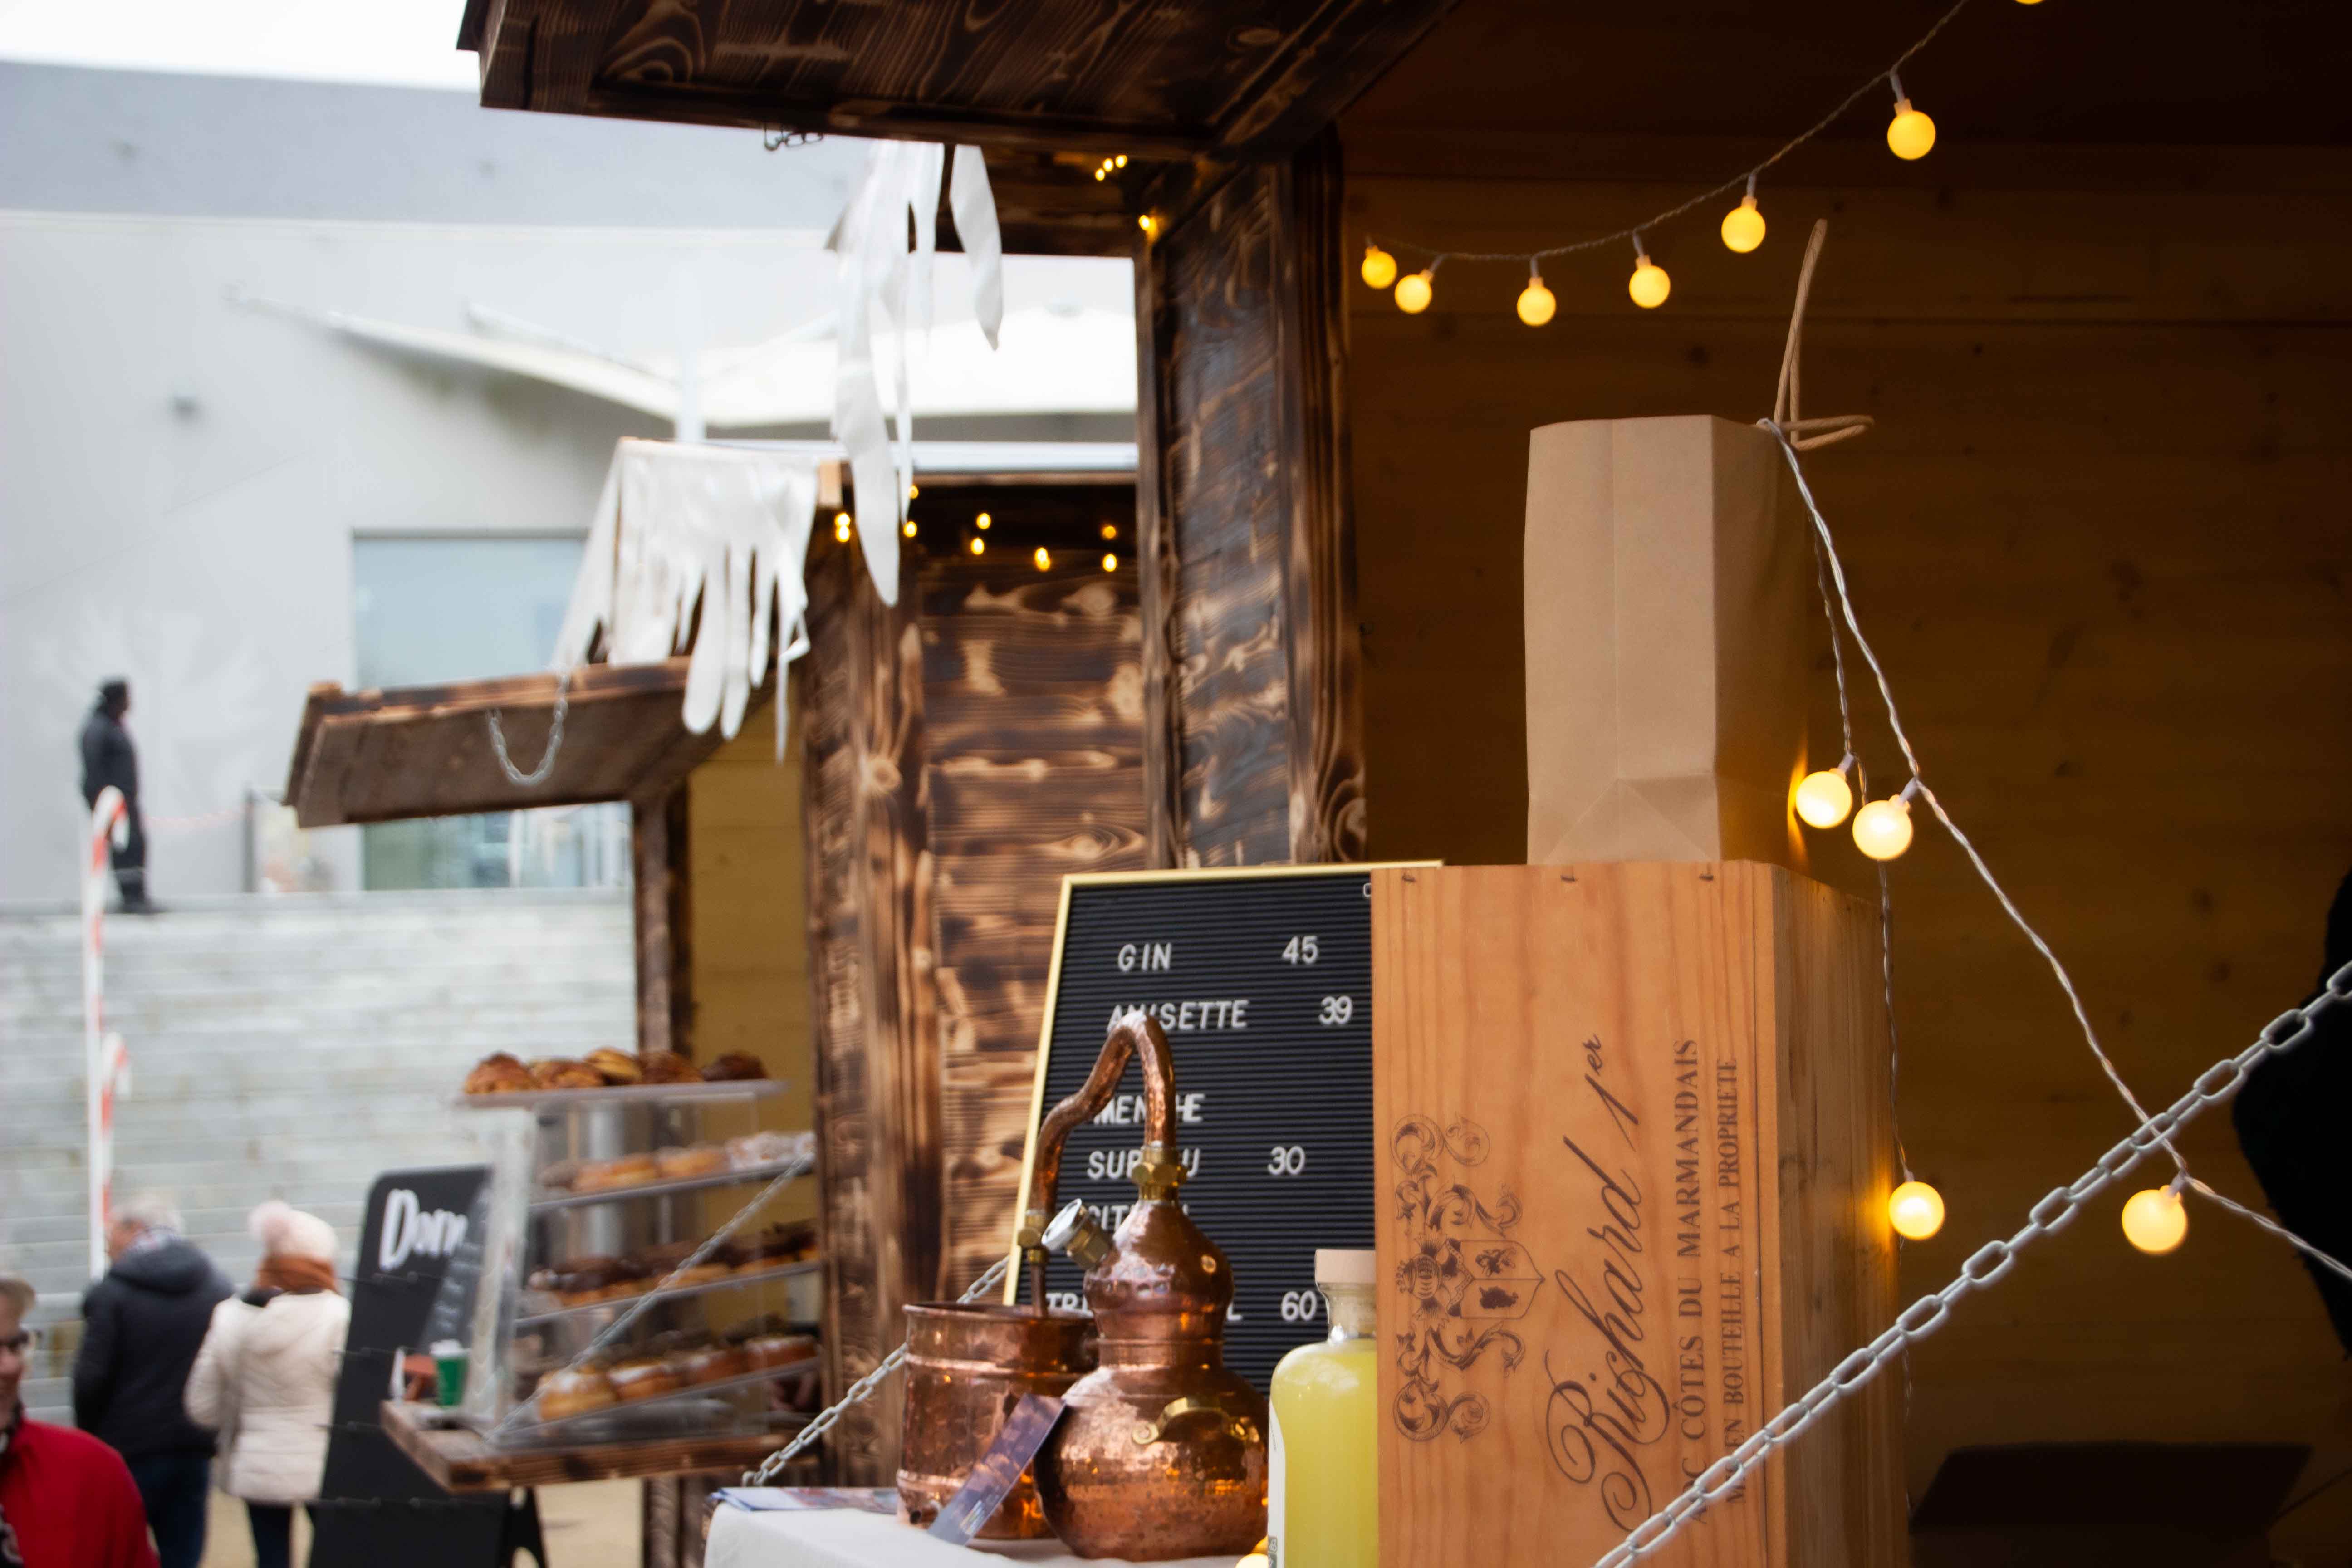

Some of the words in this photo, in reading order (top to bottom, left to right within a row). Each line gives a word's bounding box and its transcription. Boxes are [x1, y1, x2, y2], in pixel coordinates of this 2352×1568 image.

[1117, 942, 1171, 971] GIN
[1282, 935, 1318, 964] 45
[1318, 996, 1352, 1024] 39
[1716, 1058, 1739, 1188] PROPRIETE
[1268, 1146, 1305, 1175] 30
[1673, 1040, 1701, 1257] MARMANDAIS
[1719, 1201, 1741, 1230] LA
[1281, 1290, 1316, 1321] 60
[1678, 1277, 1702, 1318] DU
[1545, 1136, 1670, 1532] Richard
[1721, 1272, 1744, 1405] BOUTEILLE
[1671, 1335, 1705, 1441] CÔTES
